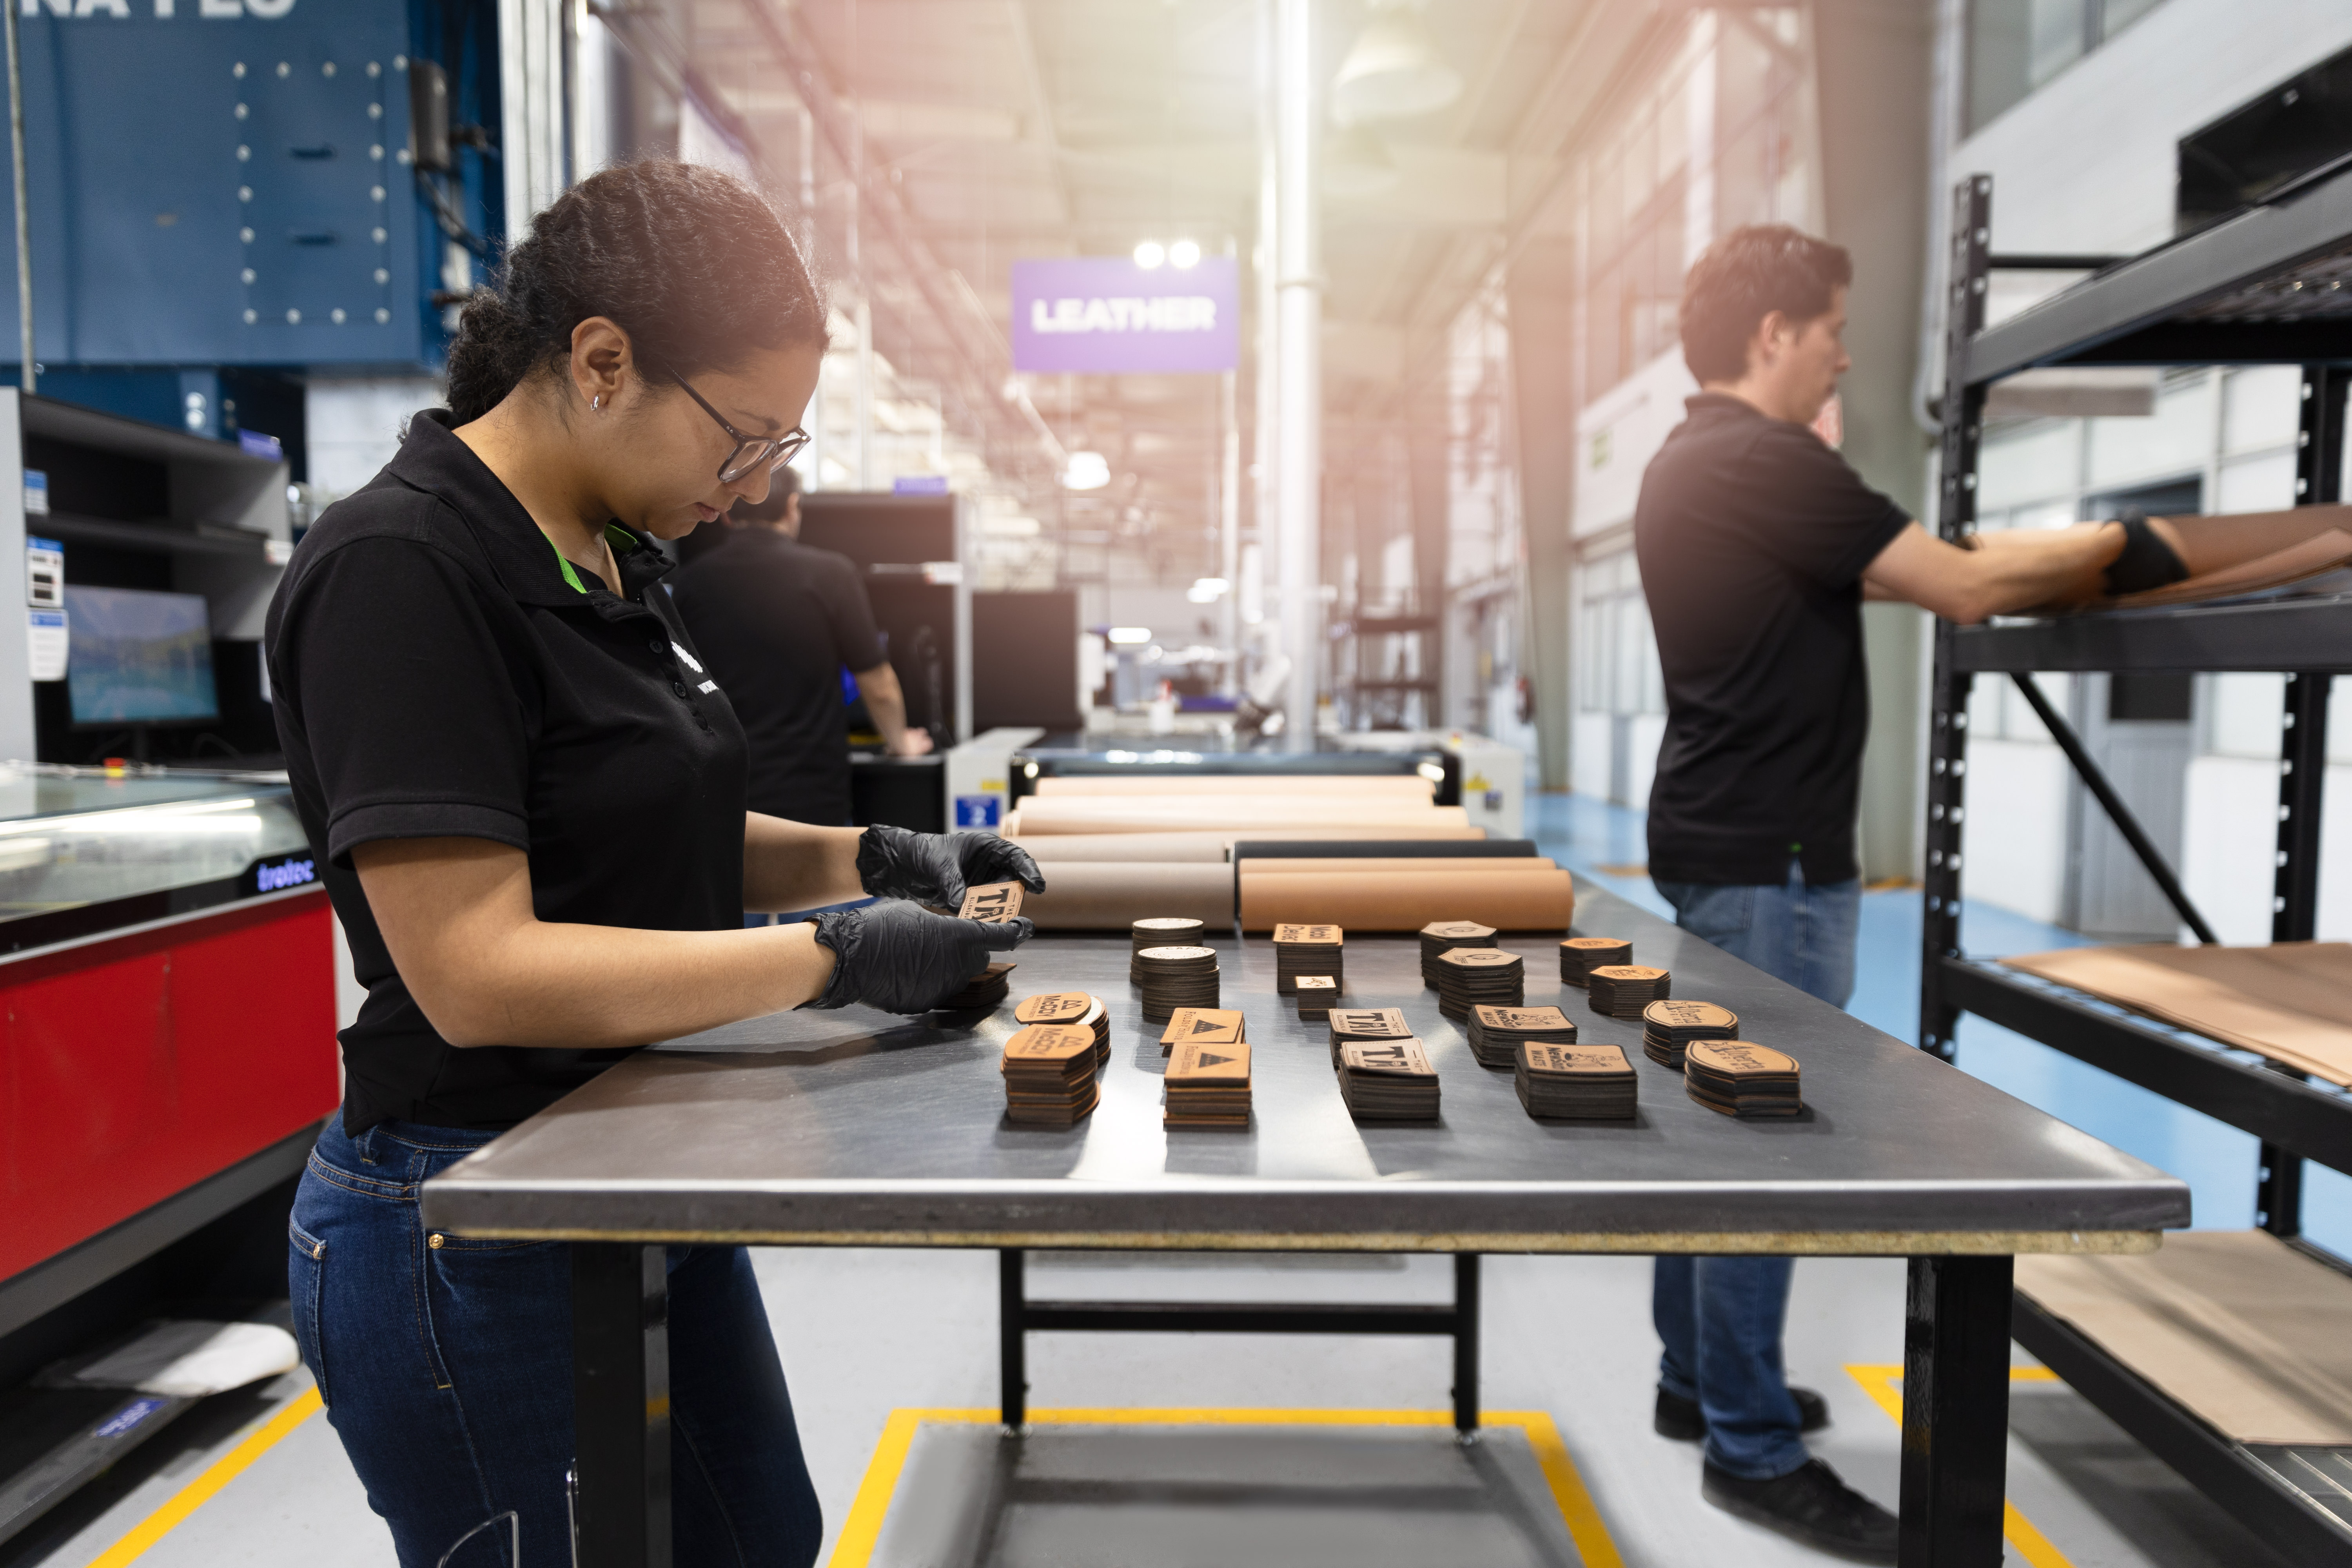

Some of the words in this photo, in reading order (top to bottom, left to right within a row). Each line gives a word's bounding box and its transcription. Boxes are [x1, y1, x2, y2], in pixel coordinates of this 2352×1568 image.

[1031, 295, 1217, 334] LEATHER
[964, 897, 975, 918] ELLENSBU
[971, 888, 1010, 923] TA
[1006, 904, 1015, 916] THE
[1281, 926, 1305, 941] Delvac
[1309, 926, 1332, 939] Mobil
[1037, 995, 1062, 1017] McCOY
[1663, 1002, 1709, 1024] Alberta
[1181, 1011, 1196, 1025] FOLDS
[1346, 1013, 1392, 1034] TAV
[1482, 1012, 1499, 1025] WASTE
[1669, 1010, 1684, 1024] PRIME
[1700, 1042, 1766, 1069] Alberta
[1719, 1053, 1744, 1070] PRIME
